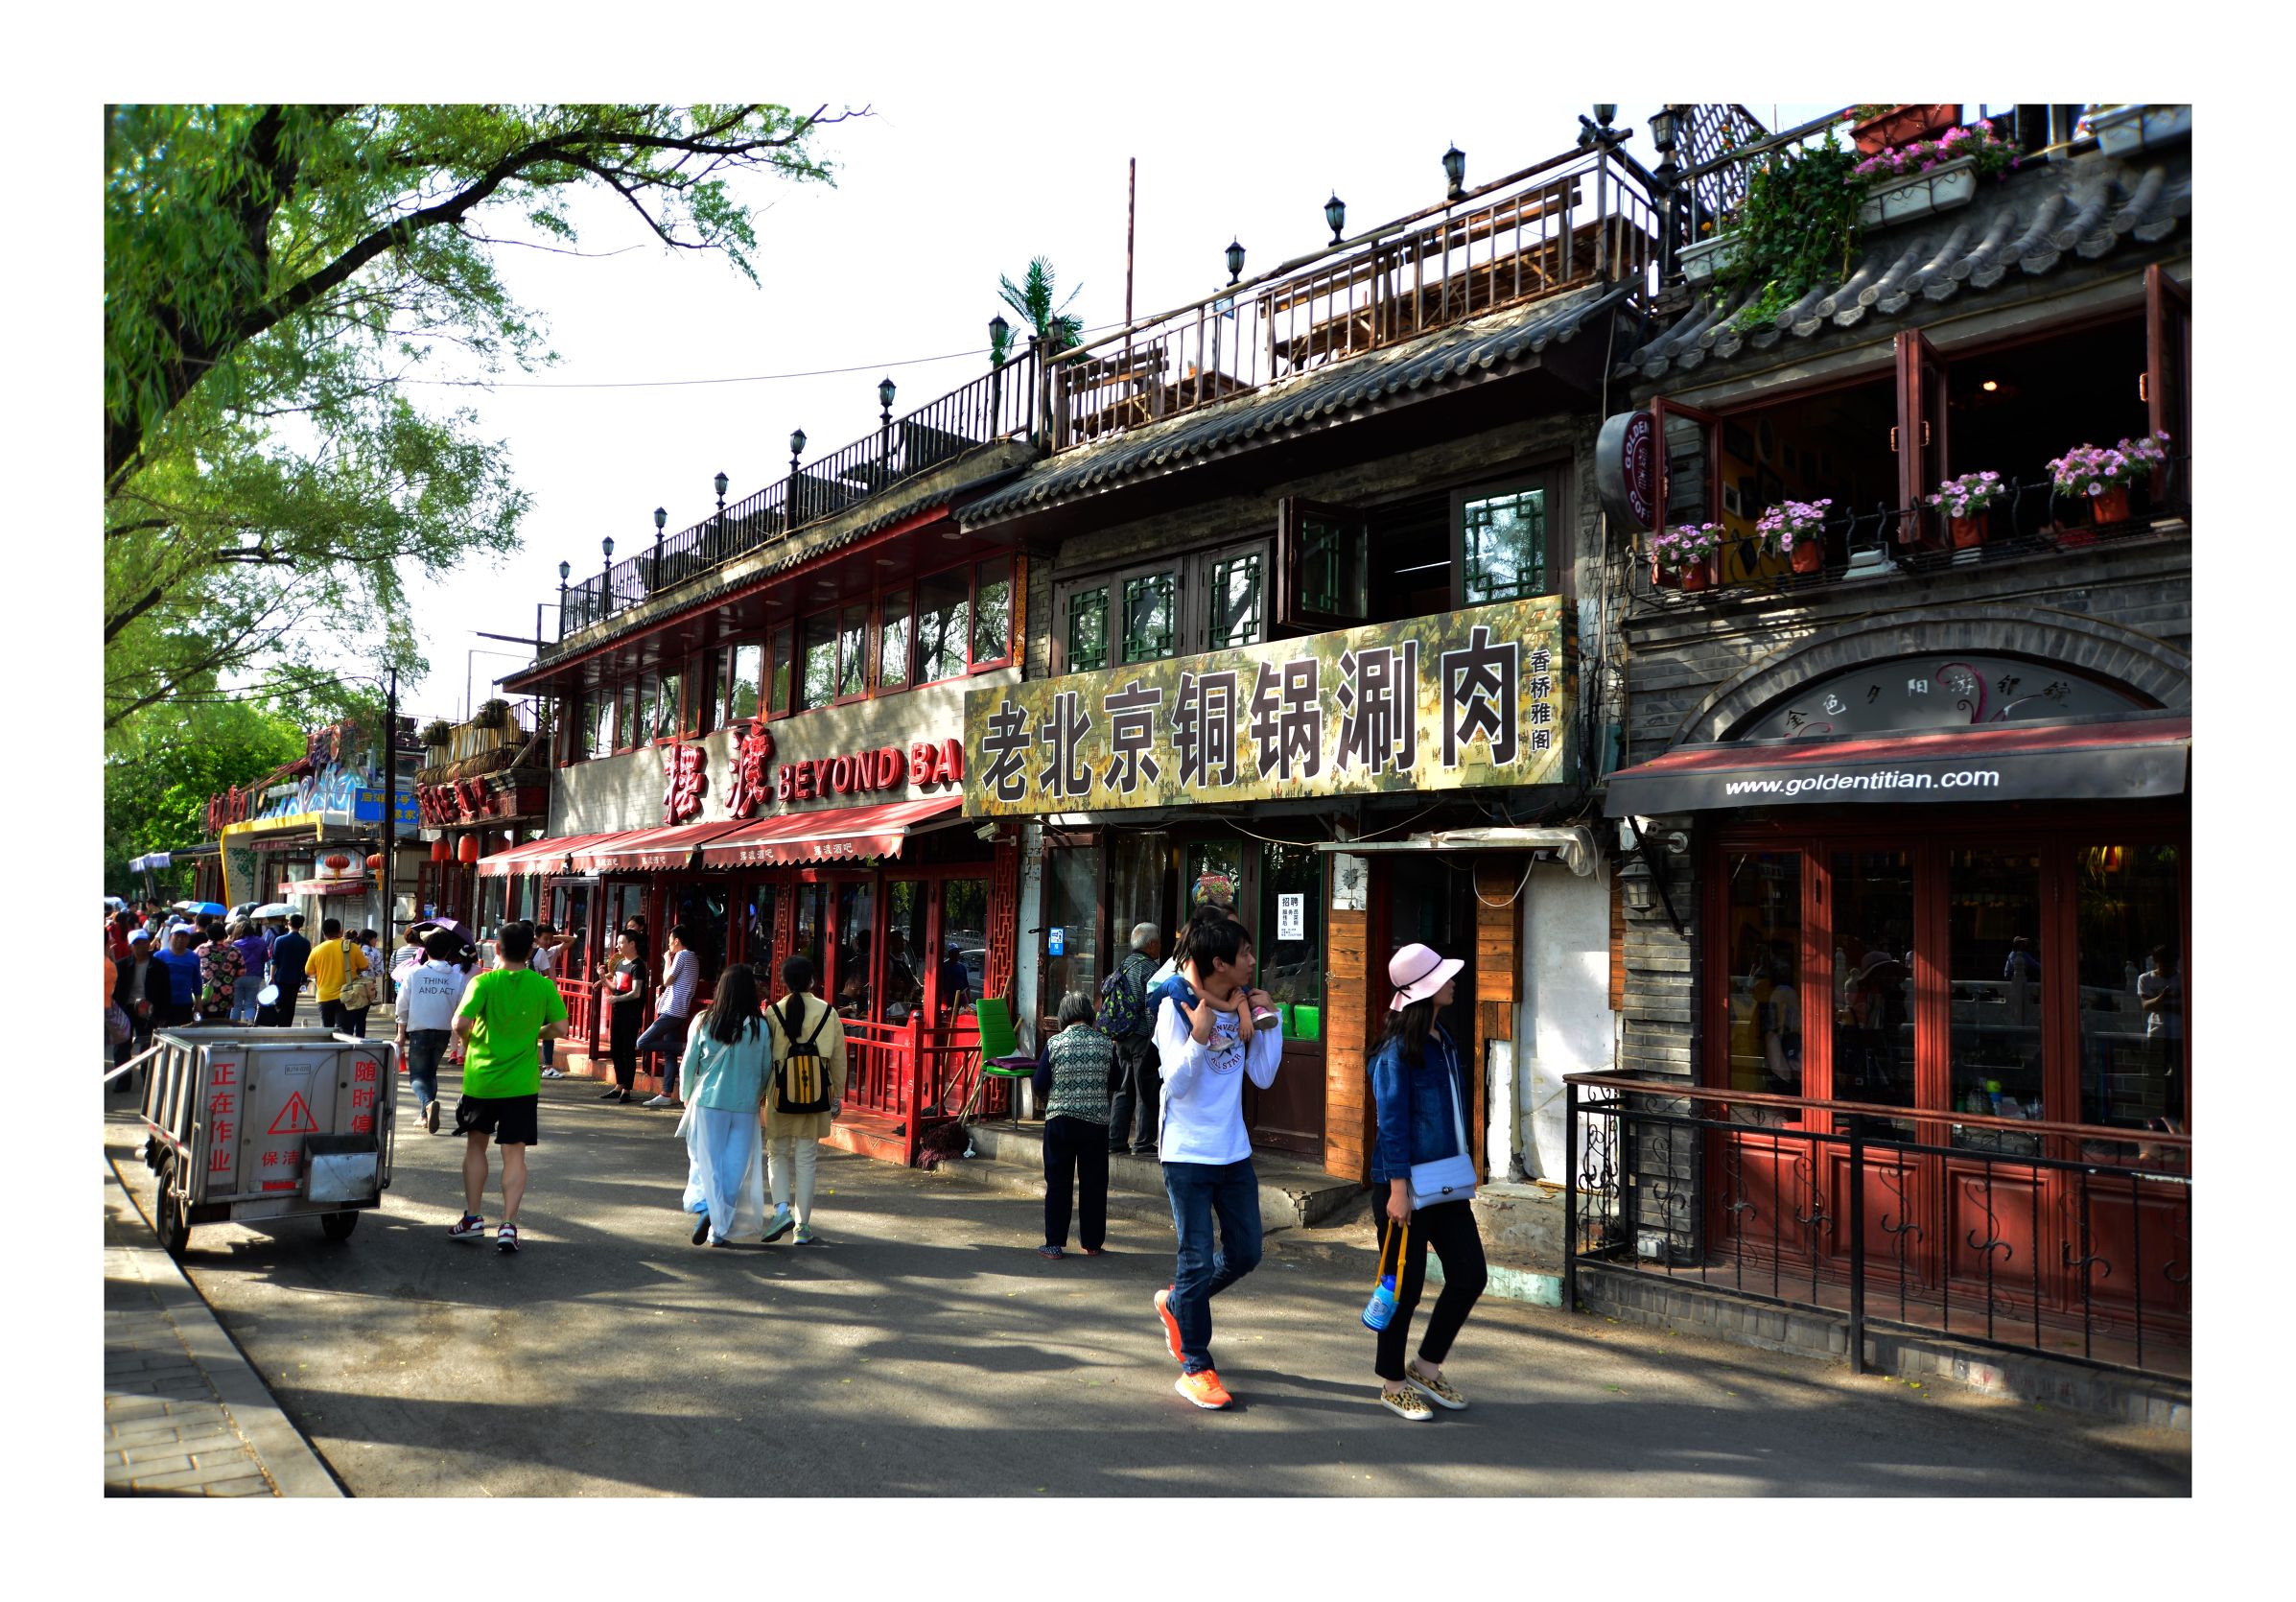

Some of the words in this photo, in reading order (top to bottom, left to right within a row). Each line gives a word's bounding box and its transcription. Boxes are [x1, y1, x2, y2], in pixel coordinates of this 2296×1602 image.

[1531, 648, 1551, 751] 香桥雅阁
[981, 625, 1519, 802] 老北京铜锅涮肉
[778, 746, 906, 803] BEYOND
[908, 738, 964, 788] BA
[1724, 768, 2001, 797] www.goldentitian.com
[1281, 897, 1299, 907] 招聘
[418, 986, 437, 995] AND
[439, 987, 456, 996] ACT
[423, 977, 449, 985] THINK
[1222, 1052, 1242, 1070] STAR
[209, 1062, 237, 1173] 正在作业
[262, 1150, 301, 1168] 保洁
